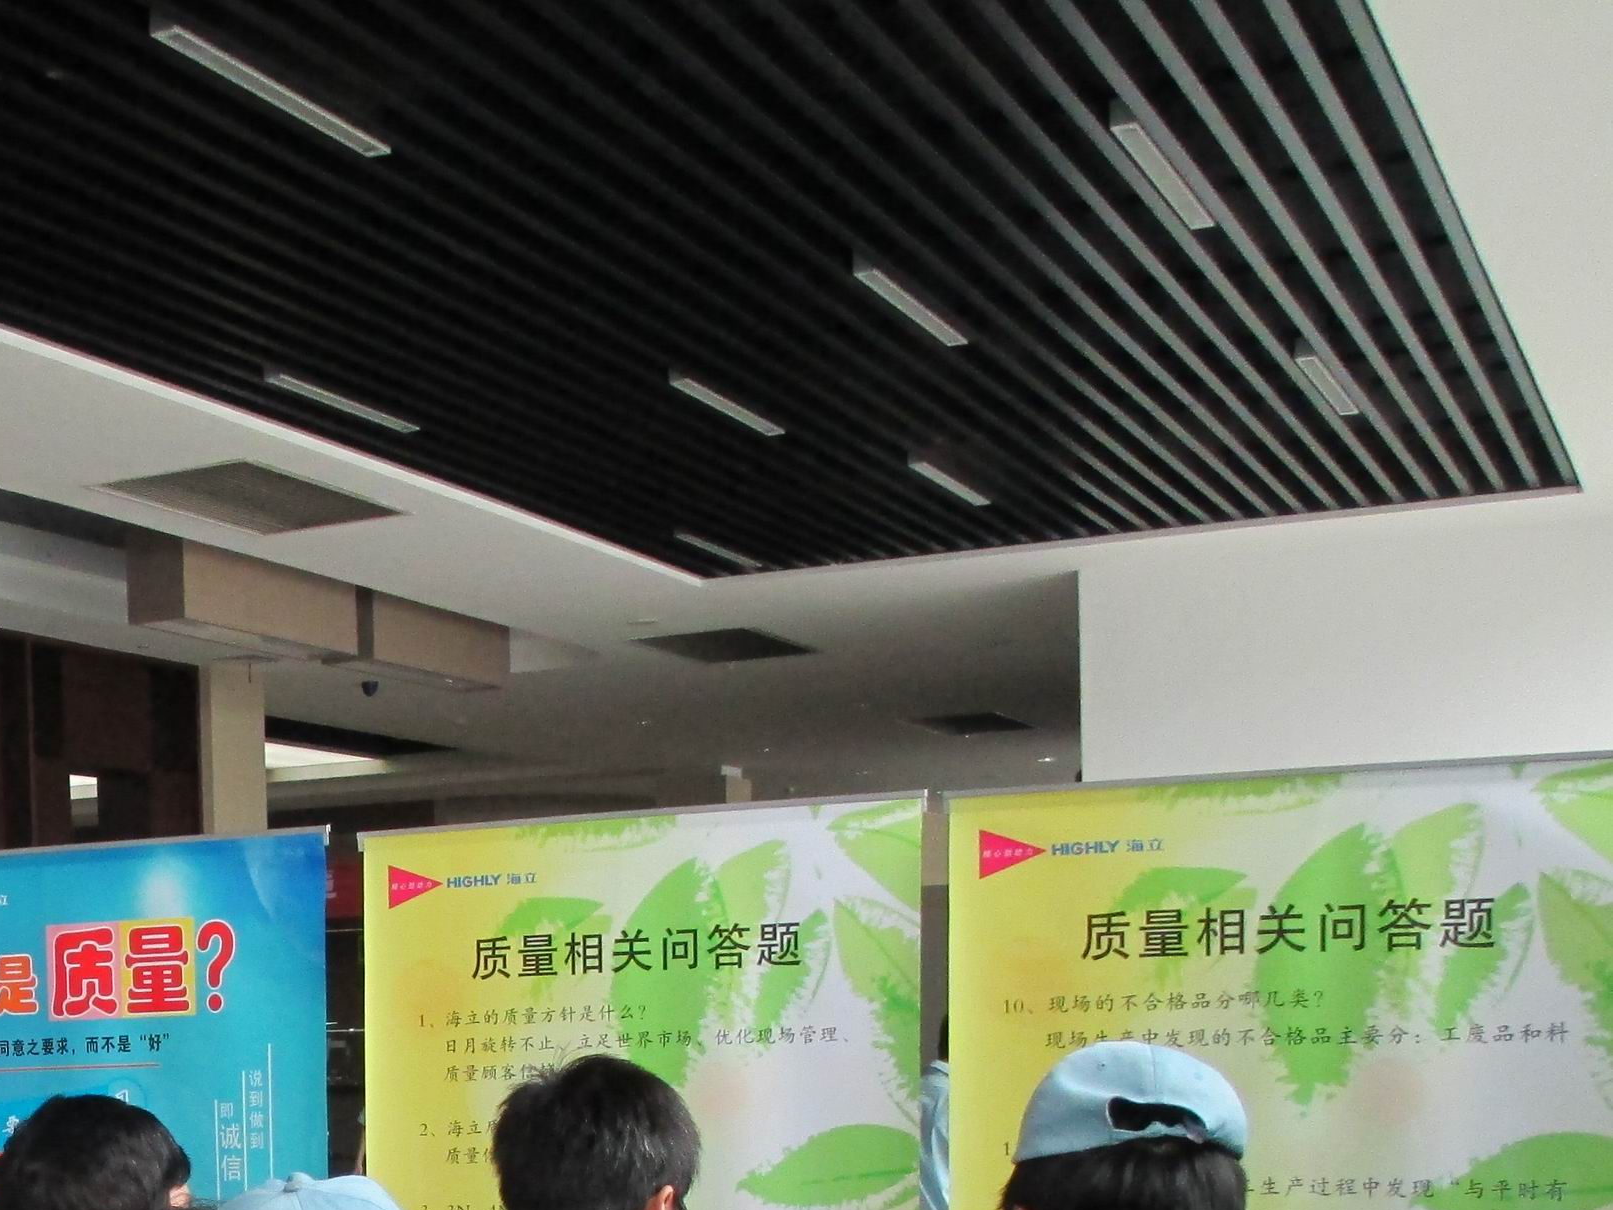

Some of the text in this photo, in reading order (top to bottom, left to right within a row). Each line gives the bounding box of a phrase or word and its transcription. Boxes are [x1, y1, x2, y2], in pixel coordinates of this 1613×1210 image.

[1050, 839, 1120, 856] HIGHLY
[1127, 838, 1165, 853] 海立
[446, 873, 502, 889] HIGHLY
[506, 872, 537, 885] 海立
[471, 921, 804, 982] 质量相关问答题
[1080, 896, 1497, 962] 质量相关问答题
[248, 1069, 264, 1150] 说到做到
[219, 1102, 242, 1182] 即诚信
[1247, 1174, 1568, 1202] 生产过程中发现“与平时有
